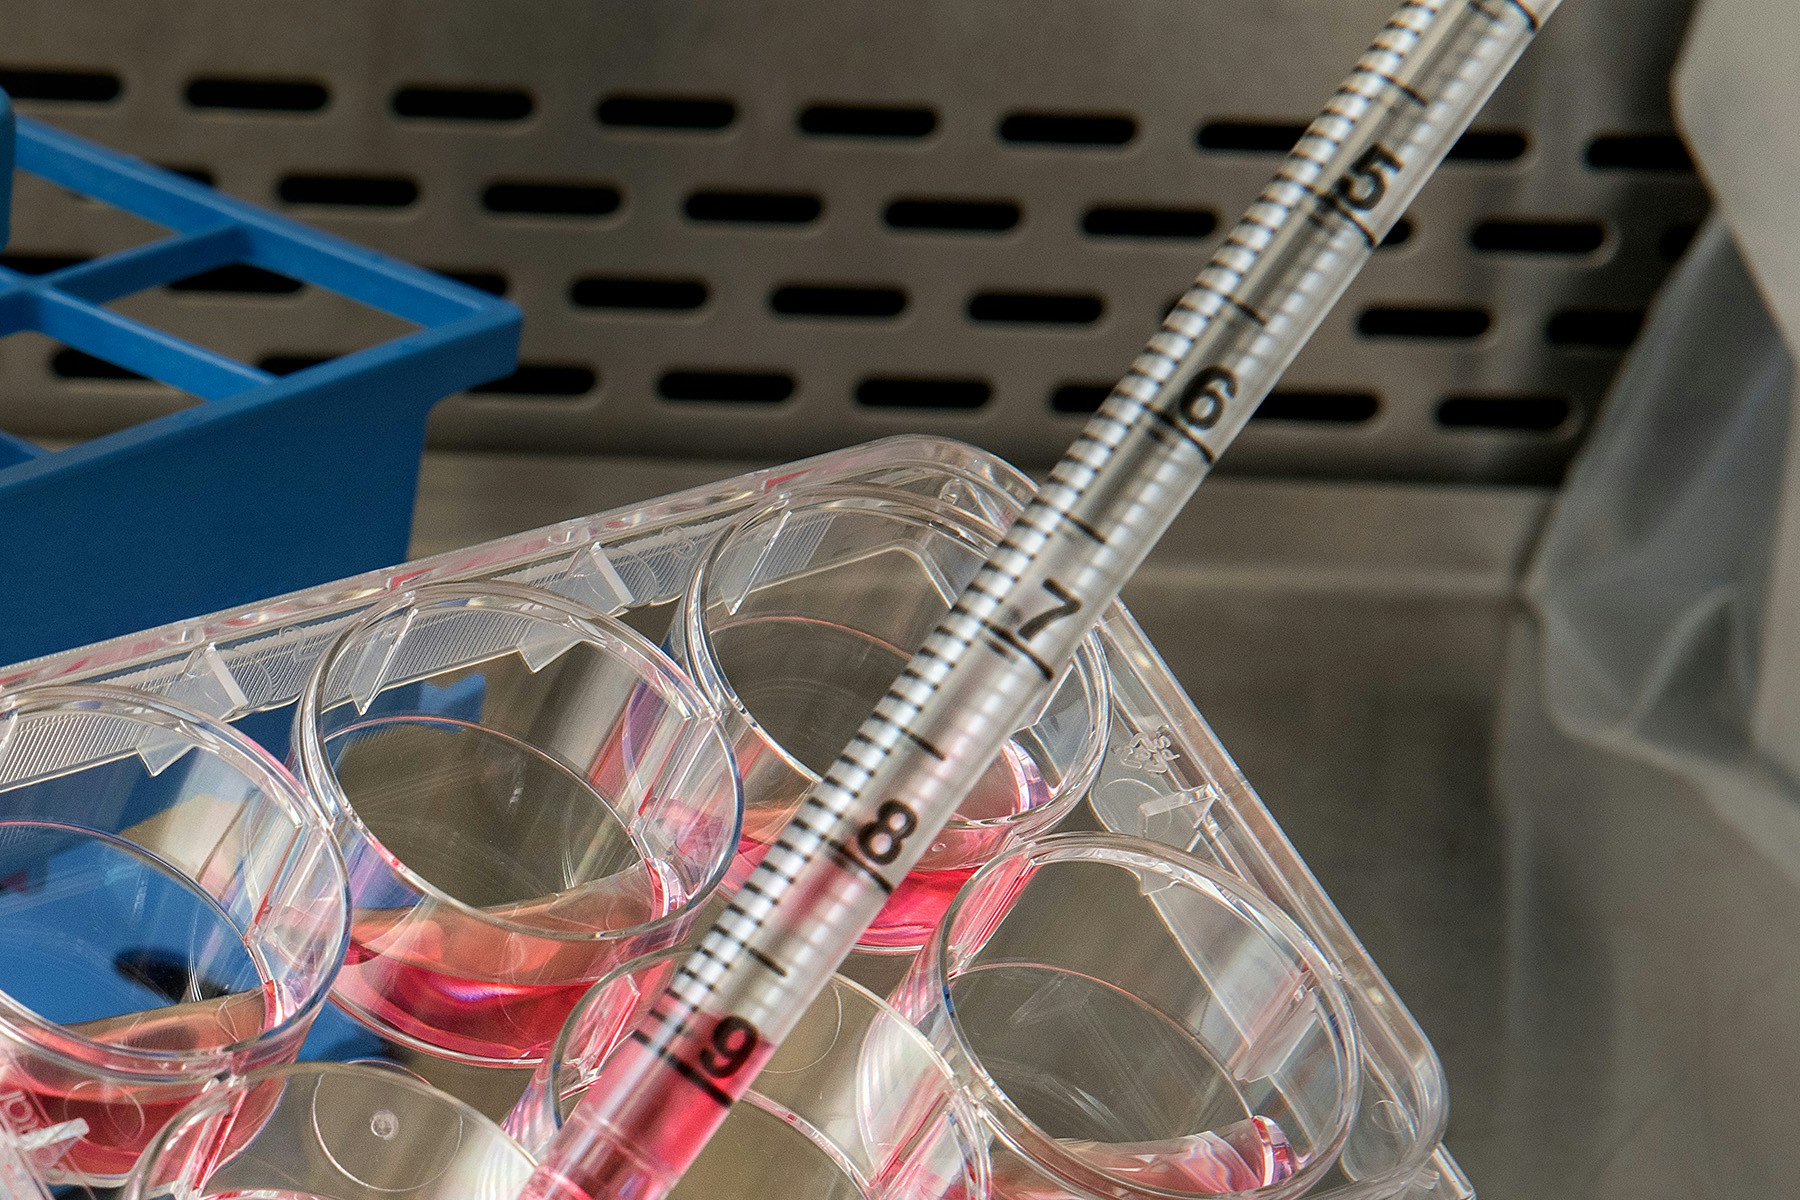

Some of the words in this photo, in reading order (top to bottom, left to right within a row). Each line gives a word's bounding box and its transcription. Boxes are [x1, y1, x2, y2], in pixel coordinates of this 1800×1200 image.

[1335, 144, 1403, 213] 5
[1177, 366, 1238, 431] 6
[1018, 579, 1081, 640] 7
[856, 799, 917, 865] 8
[697, 1015, 760, 1079] 9
